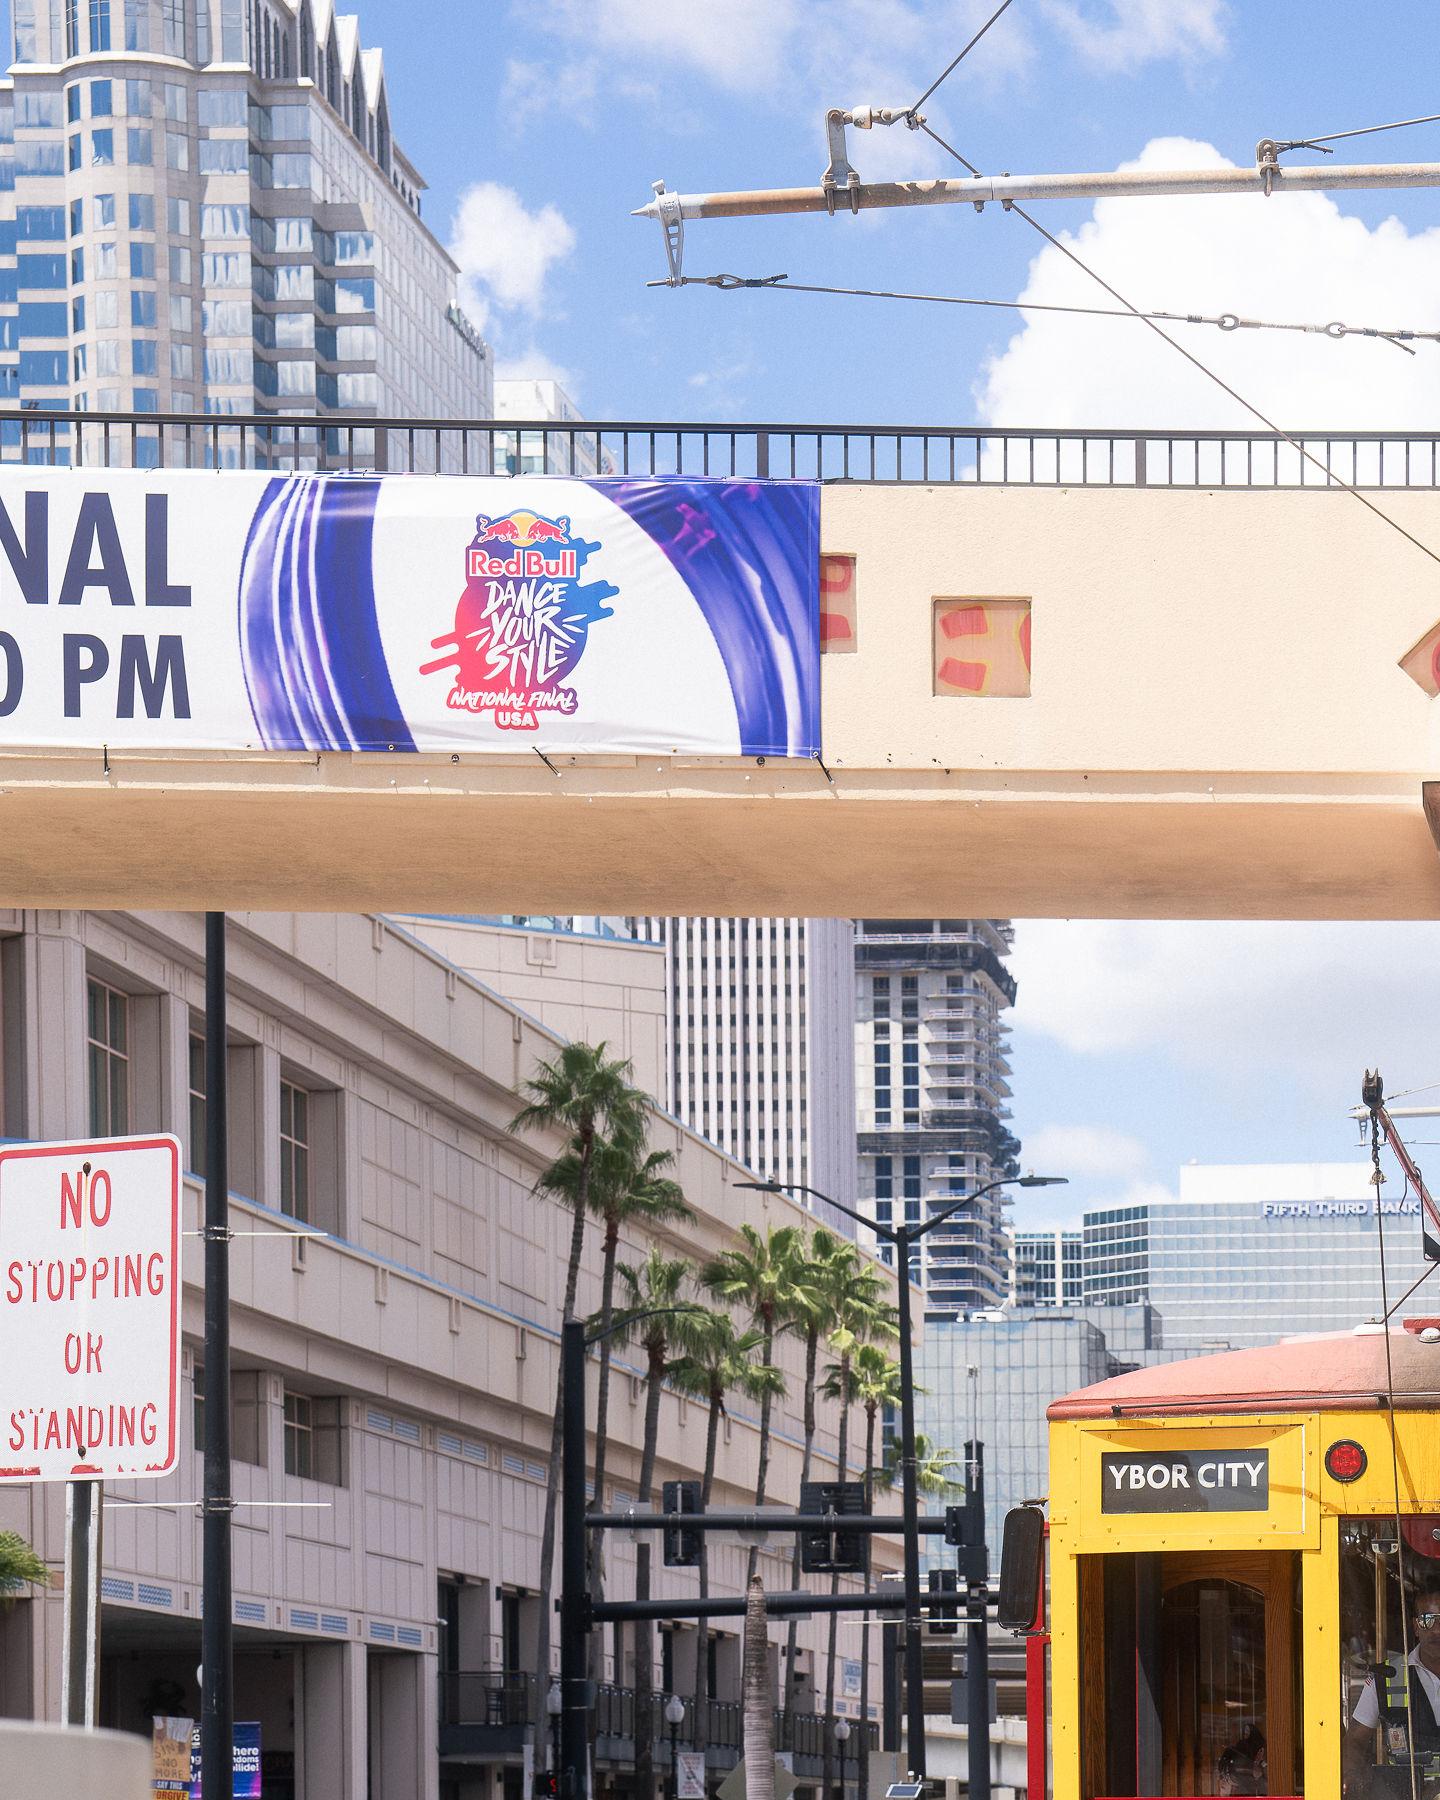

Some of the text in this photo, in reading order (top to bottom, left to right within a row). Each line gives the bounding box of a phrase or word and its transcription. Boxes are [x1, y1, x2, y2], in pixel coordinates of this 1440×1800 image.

[0, 490, 192, 607] NAL
[470, 550, 576, 577] Red Bull
[480, 578, 569, 619] DANCE
[489, 605, 576, 648] YOUR
[62, 633, 192, 719] PM
[482, 631, 571, 688] STYLE
[450, 686, 575, 711] NATIONAL FINAL
[497, 711, 536, 727] USA
[60, 1168, 112, 1230] NO
[1263, 1199, 1421, 1216] FIFTH THIRD BANK
[6, 1252, 165, 1304] STOPPING
[64, 1331, 104, 1375] OR
[9, 1402, 158, 1451] STANDING
[1108, 1461, 1265, 1491] YBOR CITY
[232, 1746, 260, 1756] here
[156, 1780, 183, 1790] SAY THIS
